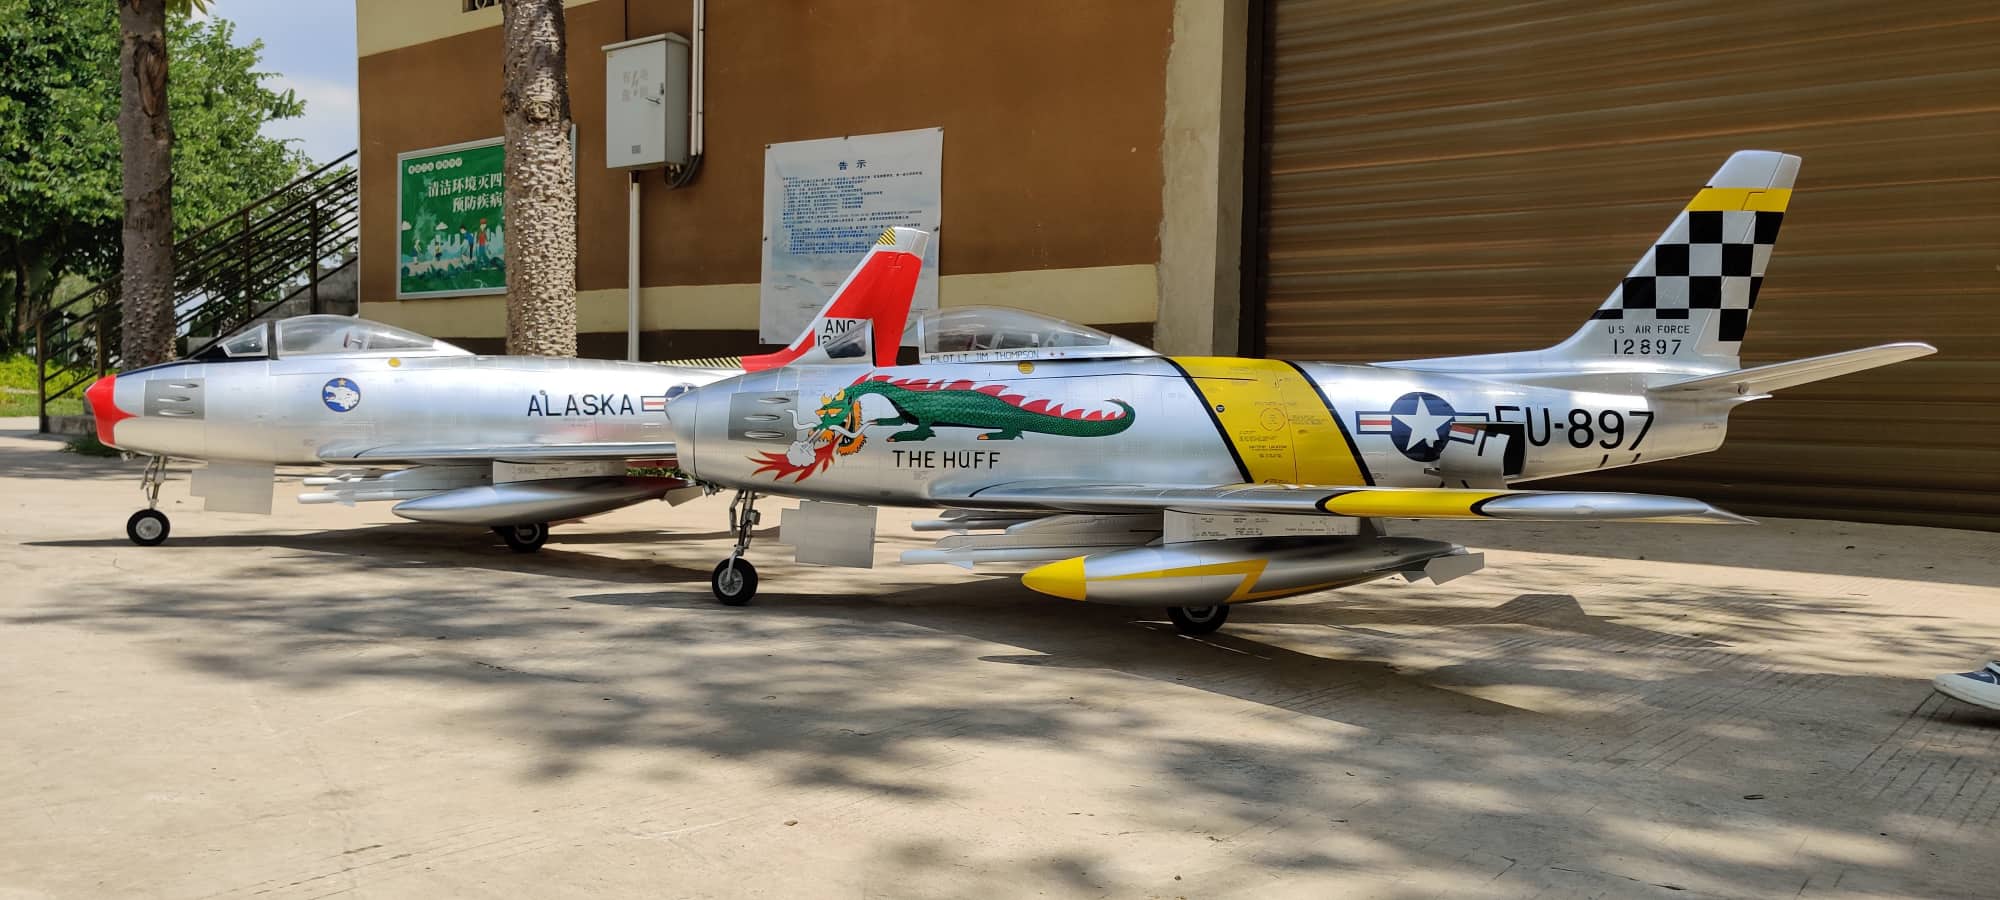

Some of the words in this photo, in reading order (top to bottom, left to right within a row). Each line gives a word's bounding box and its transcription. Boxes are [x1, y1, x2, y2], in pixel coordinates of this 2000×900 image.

[428, 172, 505, 198] 清洁环境灭四
[1635, 325, 1651, 334] AIR
[1657, 325, 1690, 334] FORCE
[995, 349, 1039, 361] THOMPSON
[1613, 338, 1682, 355] 12897
[527, 394, 635, 416] ALASKA
[892, 450, 936, 468] THE
[943, 451, 1001, 469] HUFF
